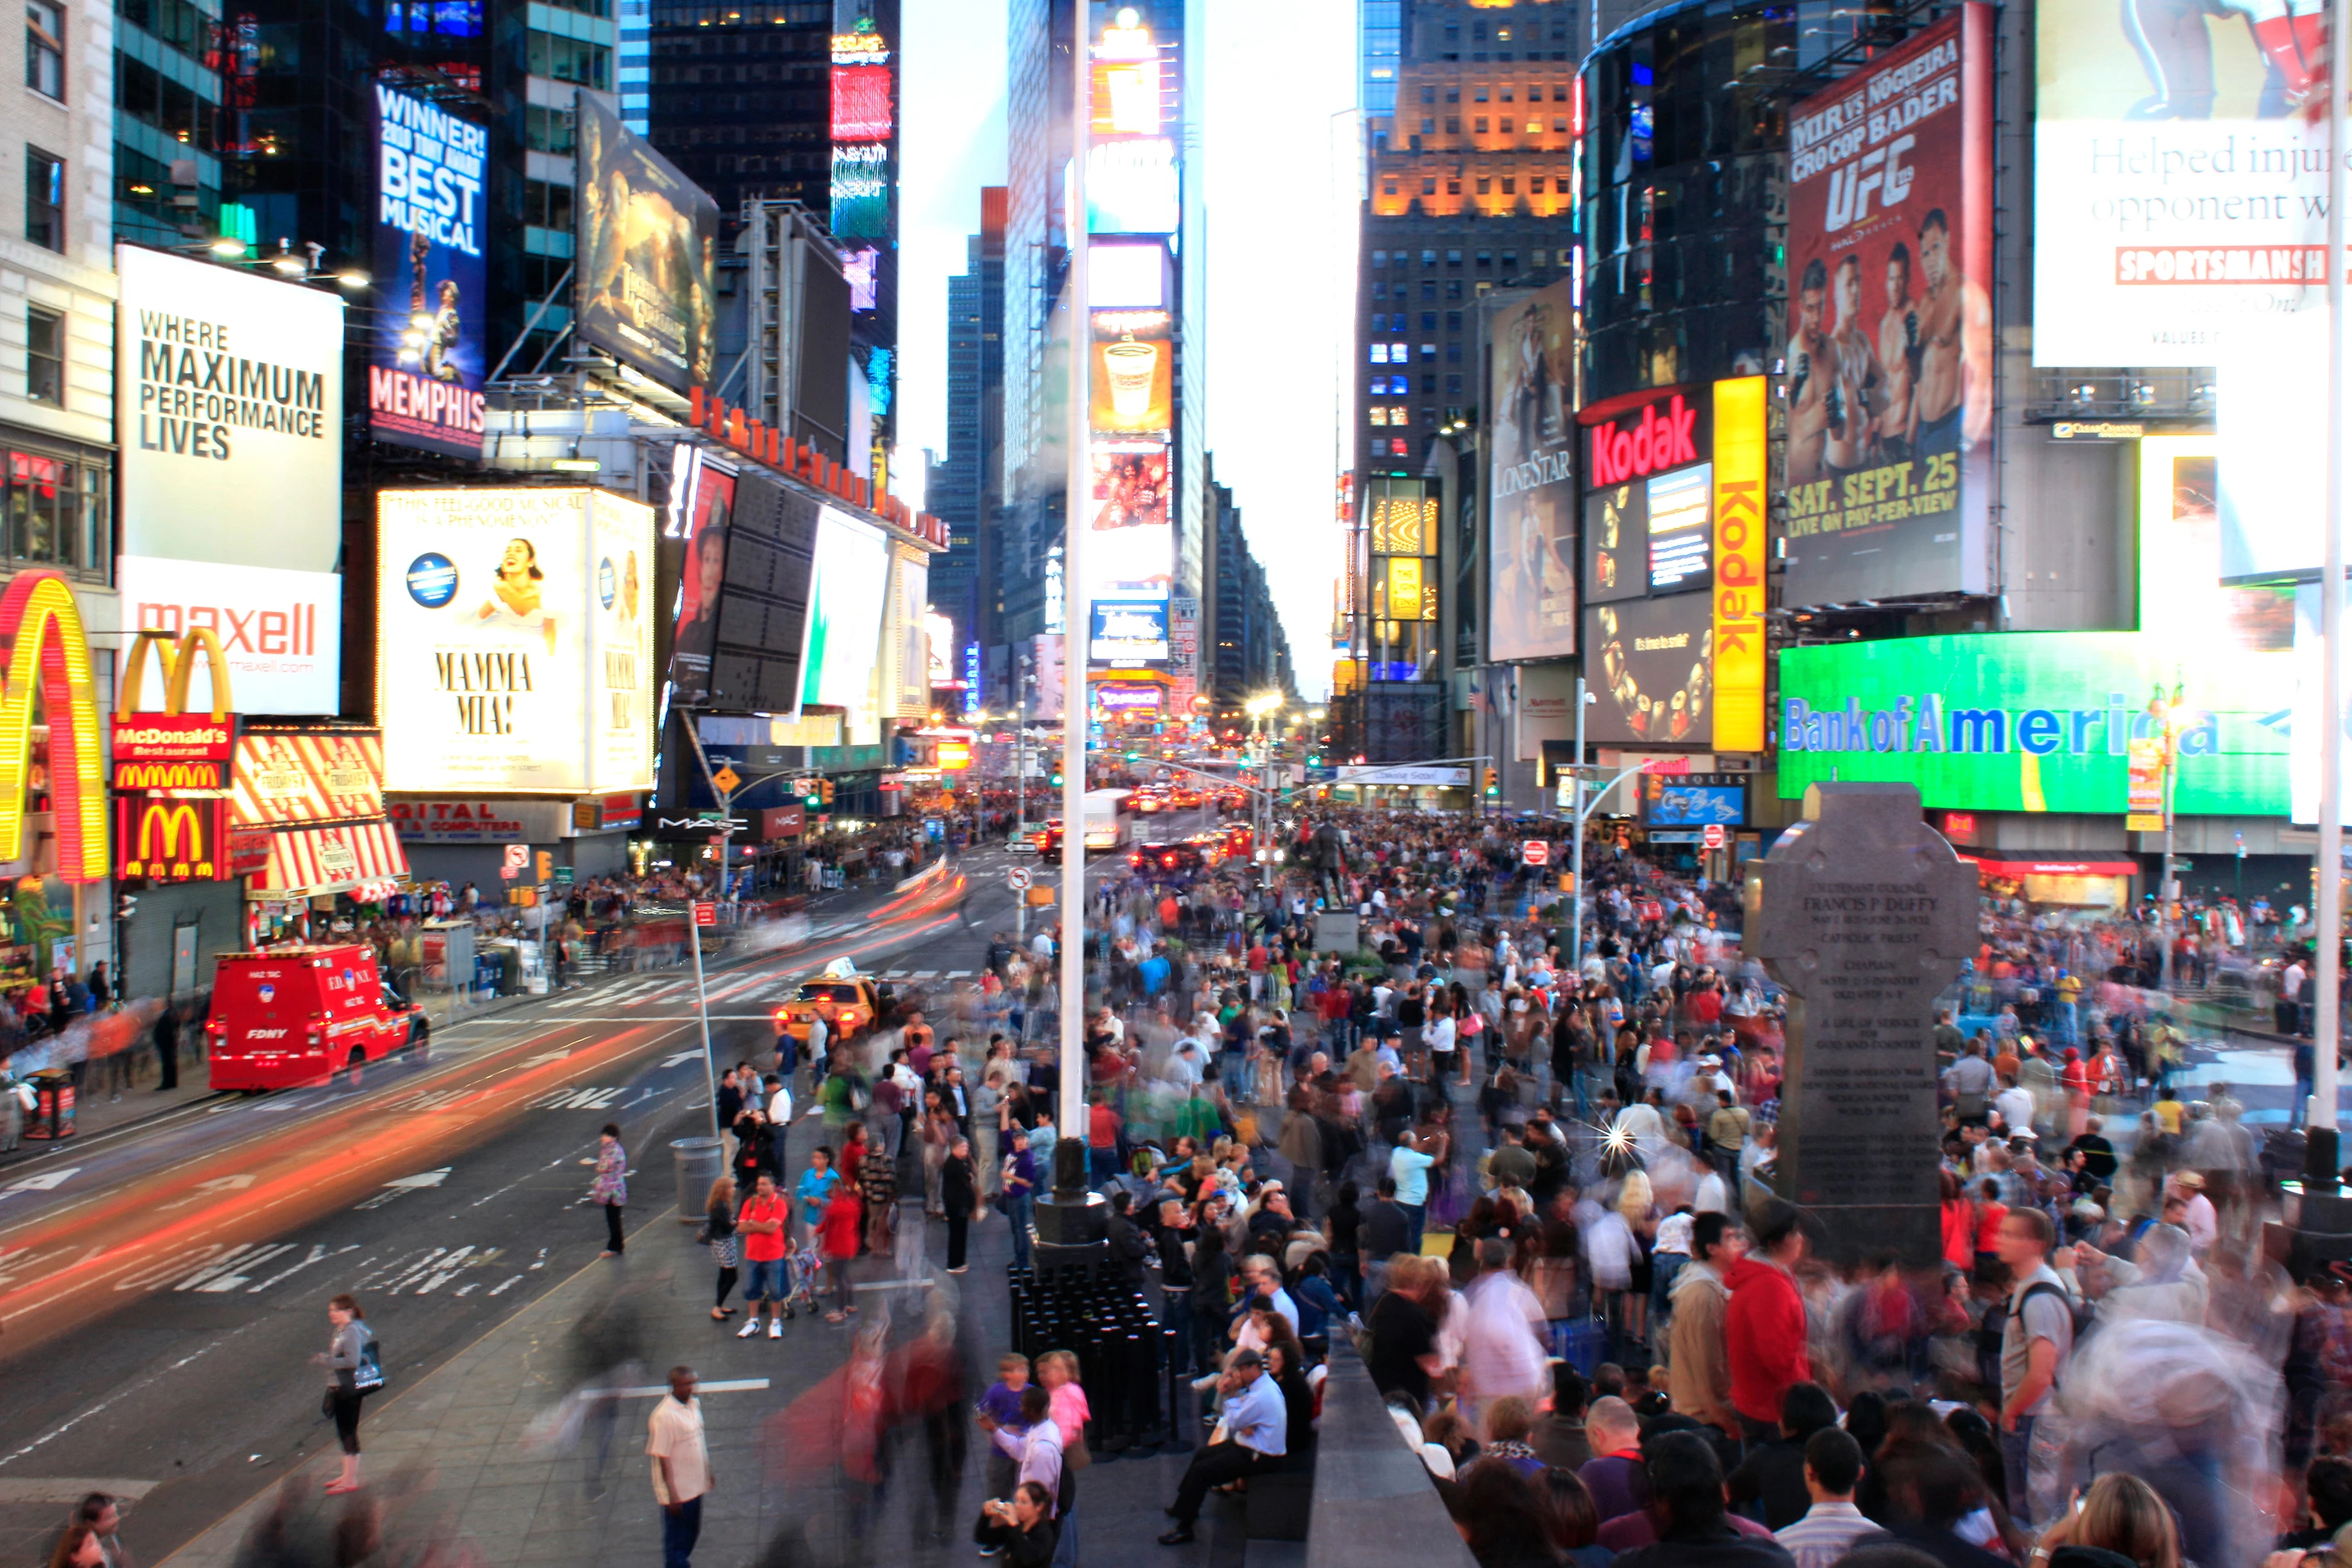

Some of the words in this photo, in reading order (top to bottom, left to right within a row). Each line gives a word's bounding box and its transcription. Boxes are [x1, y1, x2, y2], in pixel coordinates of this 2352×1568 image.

[1791, 104, 1843, 152] MIR
[1844, 94, 1865, 120] VS
[1867, 39, 1958, 108] NOGUEIRA
[1867, 77, 1958, 146] BADER
[376, 84, 485, 158] WINNER!
[381, 143, 481, 225] BEST
[1825, 133, 1916, 232] UFC
[2092, 135, 2236, 185] Helped
[380, 194, 481, 257] MUSICAL
[2092, 195, 2288, 232] opponent
[2121, 250, 2352, 282] SPORTSMANSHP
[140, 308, 229, 352] WHERE
[141, 339, 325, 411] MAXIMUM
[370, 365, 486, 434] MEMPHIS
[140, 382, 325, 439] PERFORMANCE
[140, 413, 232, 461] LIVES
[1593, 394, 1697, 488] Kodak
[1788, 479, 1836, 520] SAT.
[1843, 461, 1918, 508] SEPT.
[1923, 452, 1958, 492] 25
[1788, 516, 1819, 539] LIVE
[1821, 511, 1843, 532] ON
[1845, 489, 1958, 529] PAY-PER-VIEW
[1717, 480, 1759, 656] Kodak
[137, 602, 316, 657] maxell
[434, 652, 534, 693] MAMMA
[115, 727, 228, 746] McDonald's
[456, 694, 515, 735] MIA!
[1784, 695, 1871, 754] Bank
[1871, 693, 1915, 752] of
[133, 745, 209, 757] Restaurant
[1662, 774, 1748, 785] ARQUIS
[390, 802, 498, 819] GITAL
[430, 820, 522, 832] COMPUTERS
[1803, 897, 1867, 911] FRANCIS
[1885, 897, 1939, 912] DUFFY
[1880, 933, 1922, 943] PRIEST
[246, 1029, 289, 1039] FDNY
